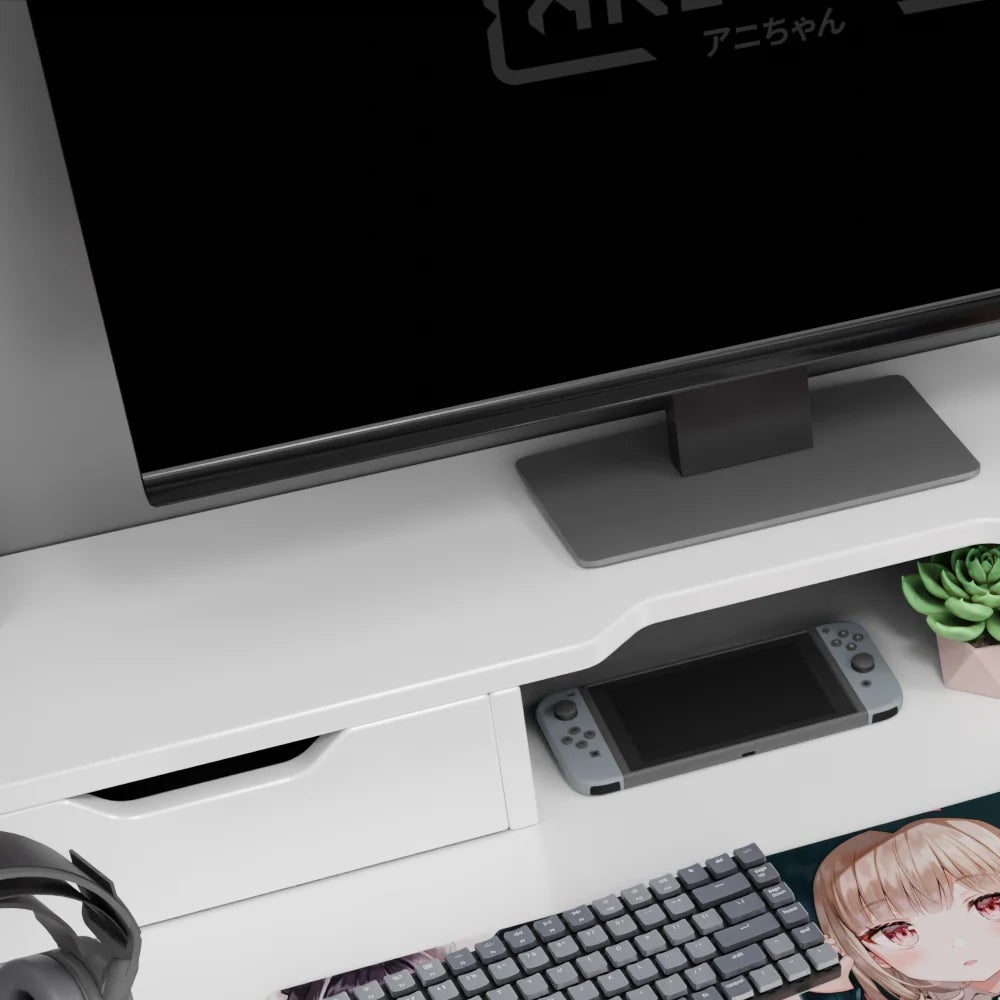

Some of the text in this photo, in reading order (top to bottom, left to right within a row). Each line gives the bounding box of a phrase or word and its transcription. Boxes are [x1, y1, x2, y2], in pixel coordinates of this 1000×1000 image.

[703, 7, 846, 58] アニちゃん
[782, 906, 798, 915] home
[800, 926, 811, 934] end
[731, 951, 745, 960] shift
[725, 978, 745, 989] control
